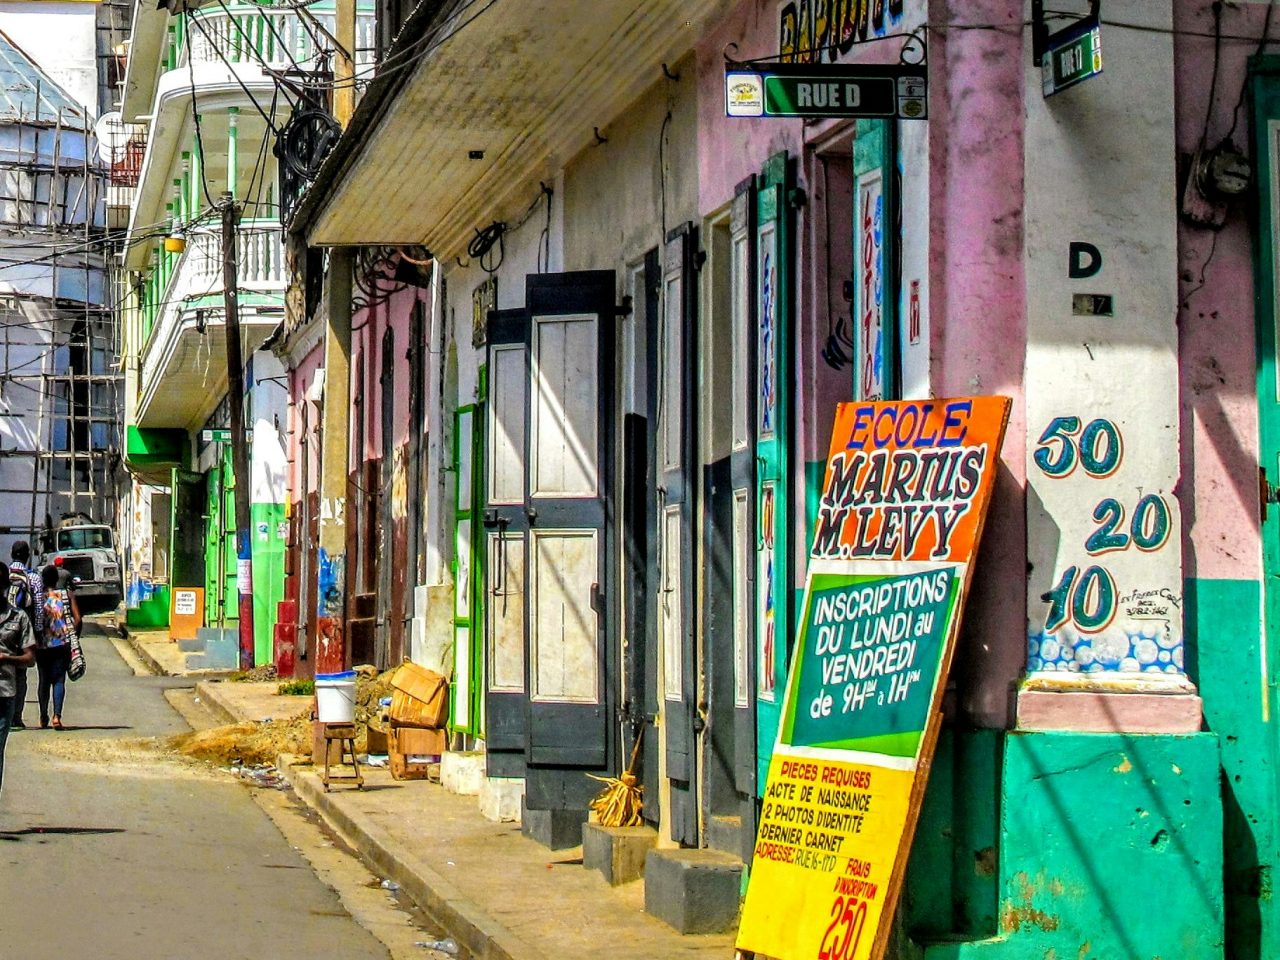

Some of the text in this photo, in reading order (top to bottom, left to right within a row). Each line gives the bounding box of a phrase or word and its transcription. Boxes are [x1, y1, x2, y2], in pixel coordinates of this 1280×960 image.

[797, 83, 861, 107] RUE D
[1069, 242, 1102, 278] D
[846, 400, 973, 450] ECOLE
[1033, 416, 1124, 479] 50
[822, 444, 987, 507] MARIUS
[1085, 494, 1172, 557] 20
[814, 571, 948, 626] INSCRIPTIONS
[1040, 565, 1119, 634] 10
[815, 611, 934, 656] DU LUNDI au
[822, 640, 917, 685] VENDREDI
[810, 689, 832, 719] de
[768, 782, 872, 812] ACTE DE NAISSANCE
[781, 761, 871, 789] PIECES REQUISES
[774, 805, 814, 825] PHOTOS
[762, 823, 844, 853] DERNIER CARNET
[845, 858, 871, 878] FRAIS
[818, 896, 867, 960] 250
